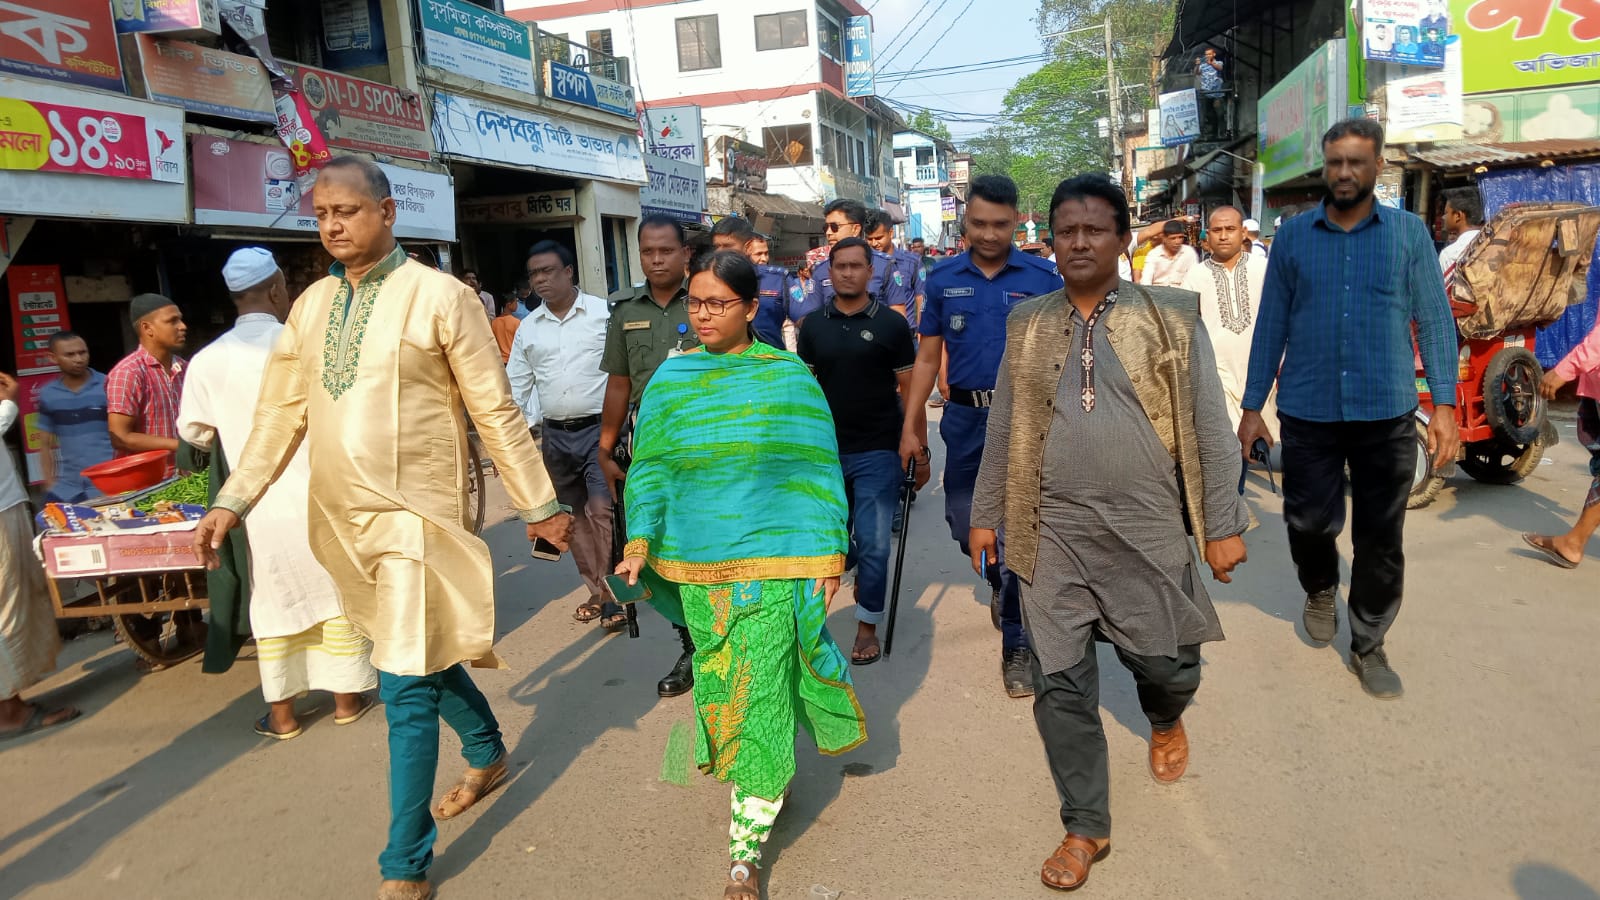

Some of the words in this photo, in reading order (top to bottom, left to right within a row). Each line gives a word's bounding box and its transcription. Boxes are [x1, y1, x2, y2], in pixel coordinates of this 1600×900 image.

[473, 15, 522, 45] কম্পিউটার
[846, 26, 866, 40] HOTEL
[63, 55, 116, 76] কম্পিউটার
[325, 77, 360, 108] N-D
[553, 67, 588, 99] স্বপন
[477, 110, 544, 153] দেশবন্ধু
[544, 123, 574, 147] মিষ্টি
[156, 157, 178, 174] বিকাশ
[527, 194, 553, 215] মিষ্টি
[554, 197, 571, 212] ঘর
